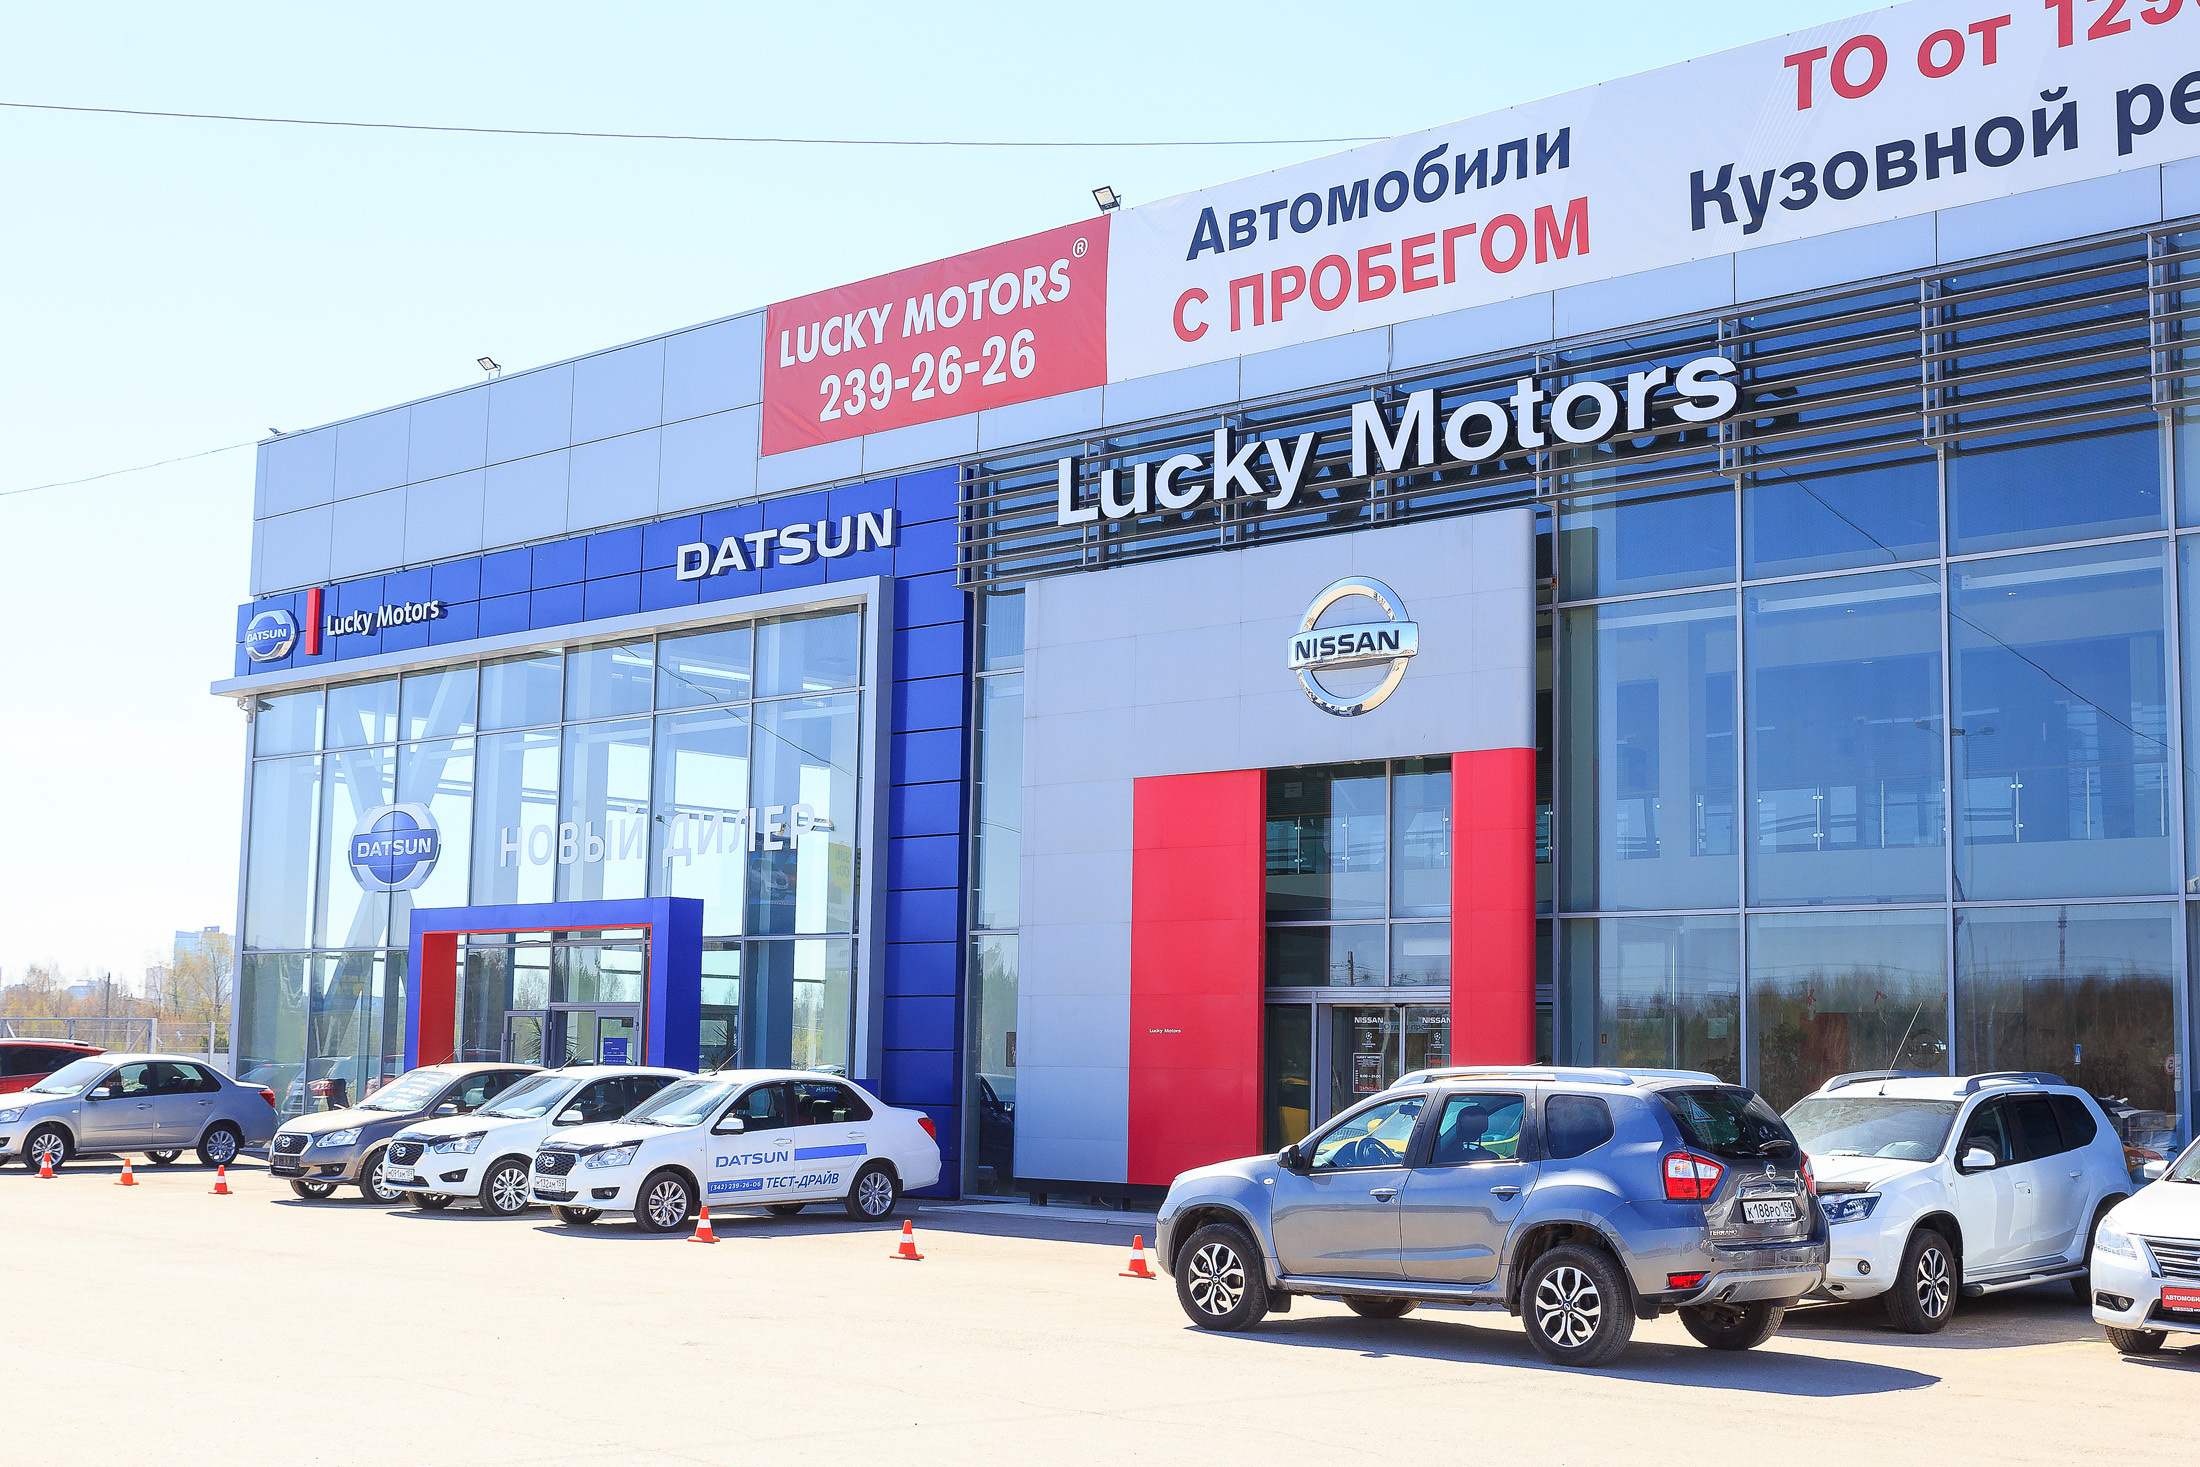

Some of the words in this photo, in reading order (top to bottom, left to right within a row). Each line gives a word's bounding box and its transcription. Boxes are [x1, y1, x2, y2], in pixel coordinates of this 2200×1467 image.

[1784, 34, 1888, 111] ТО
[1917, 14, 2011, 79] от
[1690, 86, 2079, 235] Кузовной
[2116, 70, 2200, 157] ре
[1186, 126, 1571, 261] Автомобили
[1229, 196, 1591, 332] ПРОБЕГОМ
[779, 303, 894, 369] LUCKY
[819, 329, 1036, 422] 239-26-26
[1057, 427, 1317, 526] Lucky
[1351, 356, 1738, 478] Motors
[675, 507, 894, 582] DATSUN
[247, 628, 287, 643] DATSUN
[327, 610, 373, 636] Lucky
[376, 600, 440, 628] Motors
[1295, 629, 1401, 662] NISSAN
[356, 837, 432, 858] DATSUN
[500, 804, 645, 868] НОВЫЙ
[662, 803, 817, 868] ДИЛЕР
[1354, 1016, 1384, 1024] NISSAN
[1422, 1016, 1450, 1024] NISSAN
[715, 1151, 789, 1168] DATSUN
[766, 1171, 840, 1189] ТЕСТ-ДРАЙВ
[710, 1184, 728, 1192] (342)
